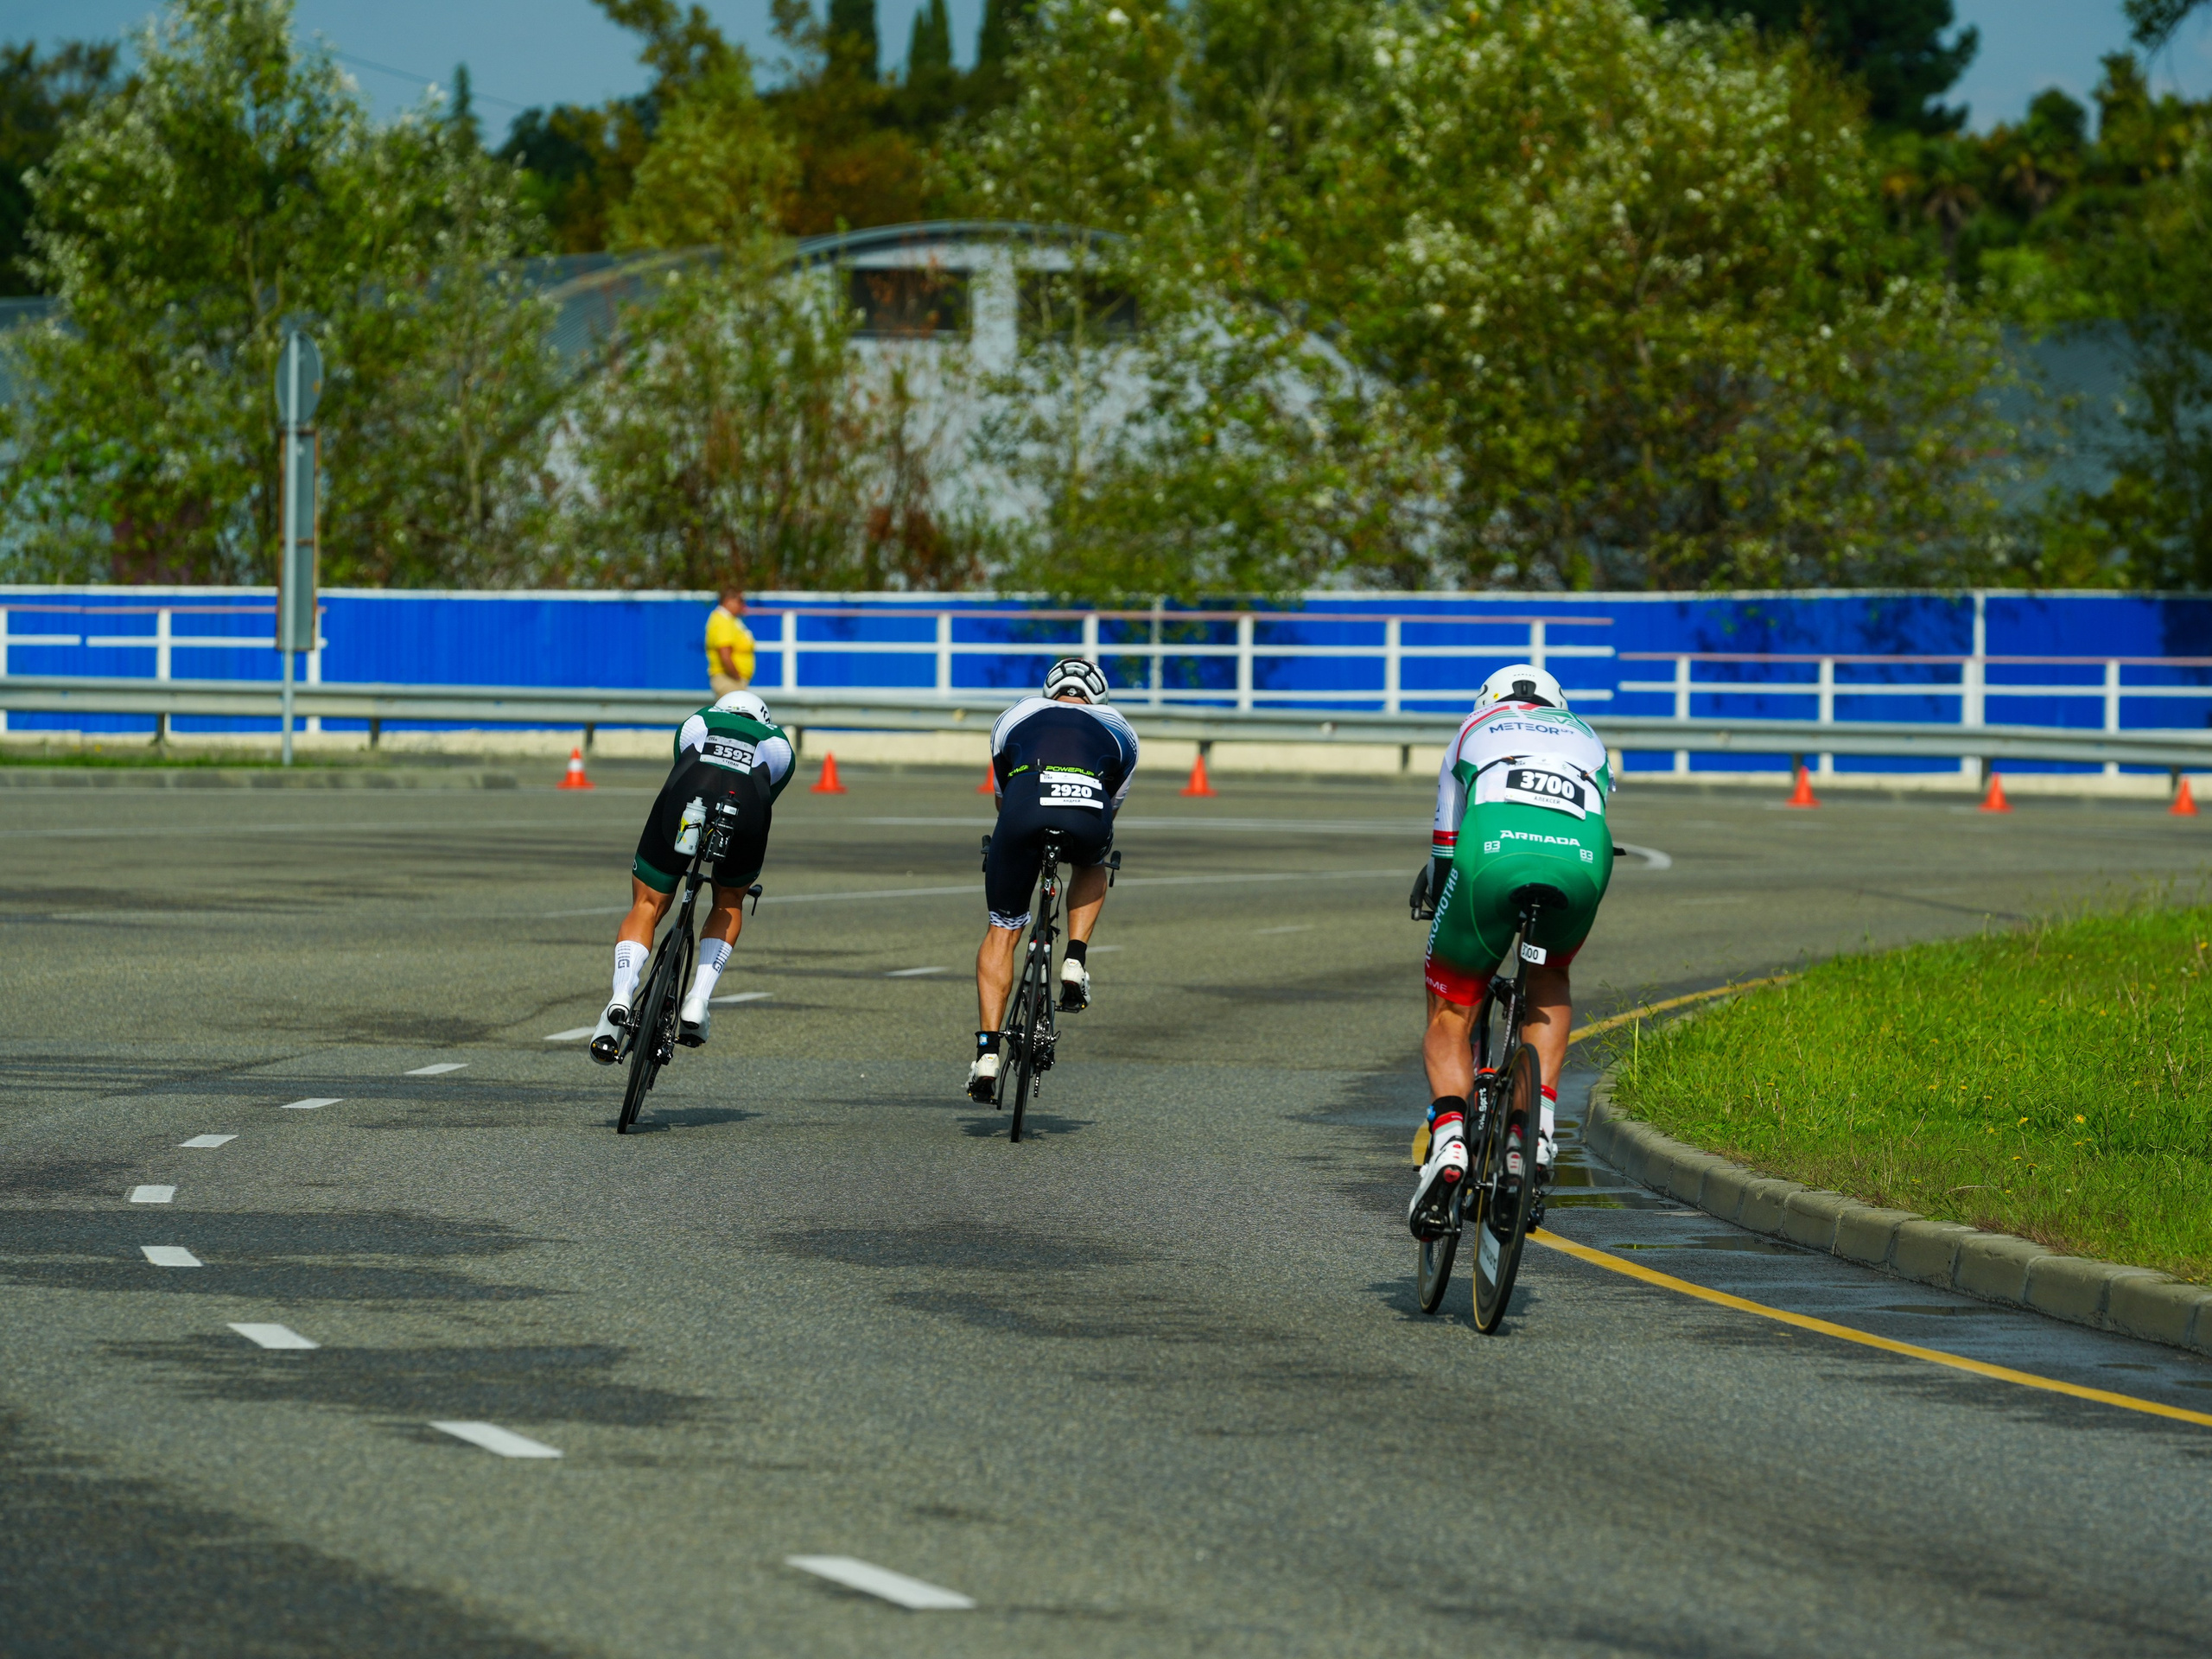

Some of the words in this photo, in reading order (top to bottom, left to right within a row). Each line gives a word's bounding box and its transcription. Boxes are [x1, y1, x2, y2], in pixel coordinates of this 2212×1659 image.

[1489, 721, 1560, 735] METEOR
[713, 745, 753, 766] 3592
[1046, 766, 1095, 777] POWERUP
[1051, 784, 1093, 798] 2920
[1520, 771, 1575, 799] 3700
[1534, 795, 1561, 804] АЛЕКСЕЙ
[1499, 830, 1581, 847] ARMADA
